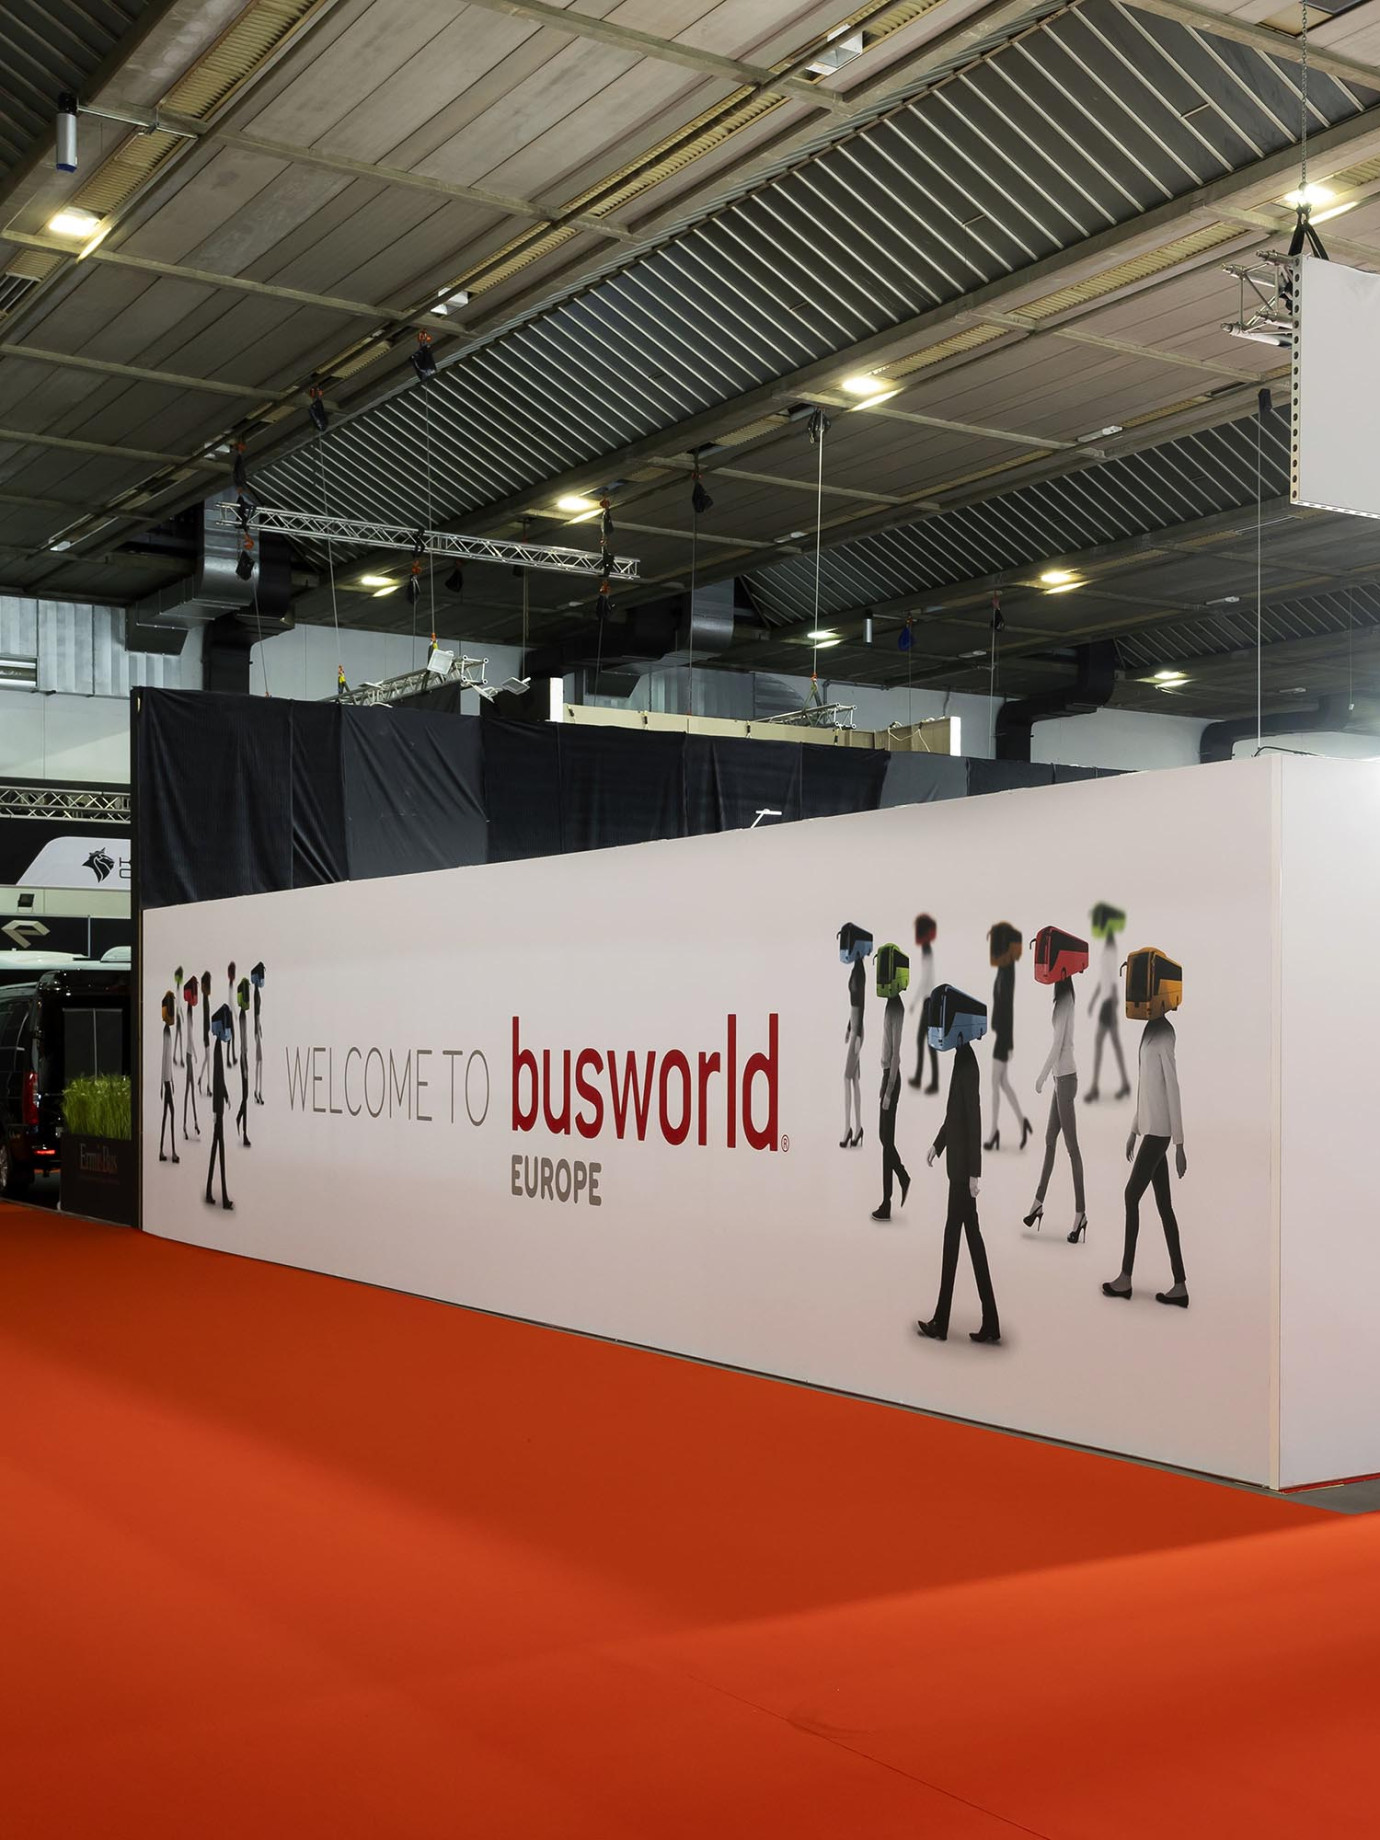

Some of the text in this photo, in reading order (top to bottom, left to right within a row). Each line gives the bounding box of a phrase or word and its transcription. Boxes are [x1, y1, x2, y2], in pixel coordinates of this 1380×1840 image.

[285, 1047, 433, 1122] WELCOME
[442, 1049, 490, 1126] TO
[511, 1154, 602, 1207] EUROPE
